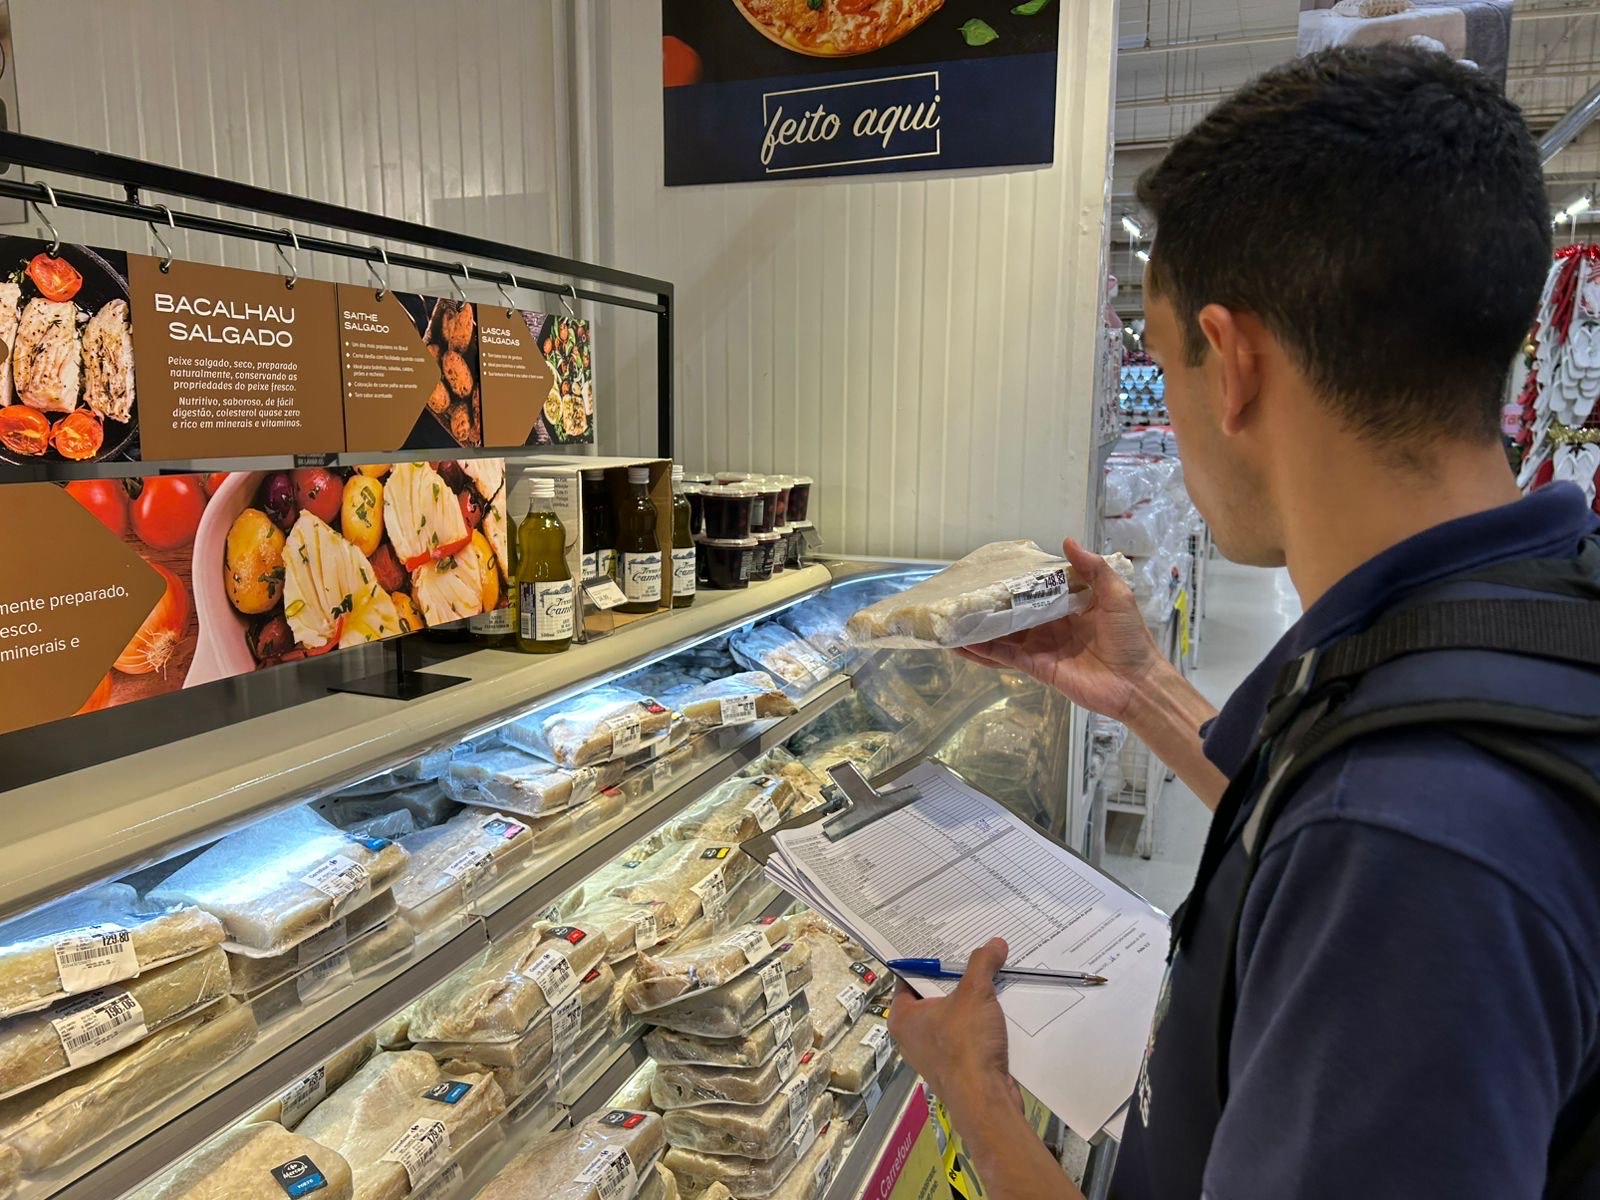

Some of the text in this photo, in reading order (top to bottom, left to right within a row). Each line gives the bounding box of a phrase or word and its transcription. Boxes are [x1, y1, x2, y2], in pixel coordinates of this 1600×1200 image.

[760, 95, 940, 165] feito aqui
[155, 293, 295, 324] BACALHAU
[343, 310, 378, 322] SAITHE
[344, 322, 390, 334] SALGADO
[481, 326, 511, 337] LASCAS
[168, 321, 293, 348] SALGADO
[481, 335, 520, 347] SALGADAS
[168, 356, 298, 371] Peixe salgado, seco, preparado
[170, 369, 297, 381] naturalmente, conservando as
[173, 380, 296, 392] propriedades do peixe fresco.
[178, 396, 294, 408] Nutritivo, saboroso, de fácil
[172, 407, 214, 419] digestão,
[216, 408, 257, 417] colesterol
[258, 409, 282, 418] quase
[172, 421, 178, 429] e
[180, 420, 198, 429] rico
[199, 420, 214, 429] em
[215, 419, 253, 428] minerais
[261, 418, 302, 428] vitaminas.
[50, 584, 129, 611] preparado,
[0, 622, 42, 639] esco.
[0, 637, 80, 662] minerais e
[880, 1131, 913, 1198] Carrefour
